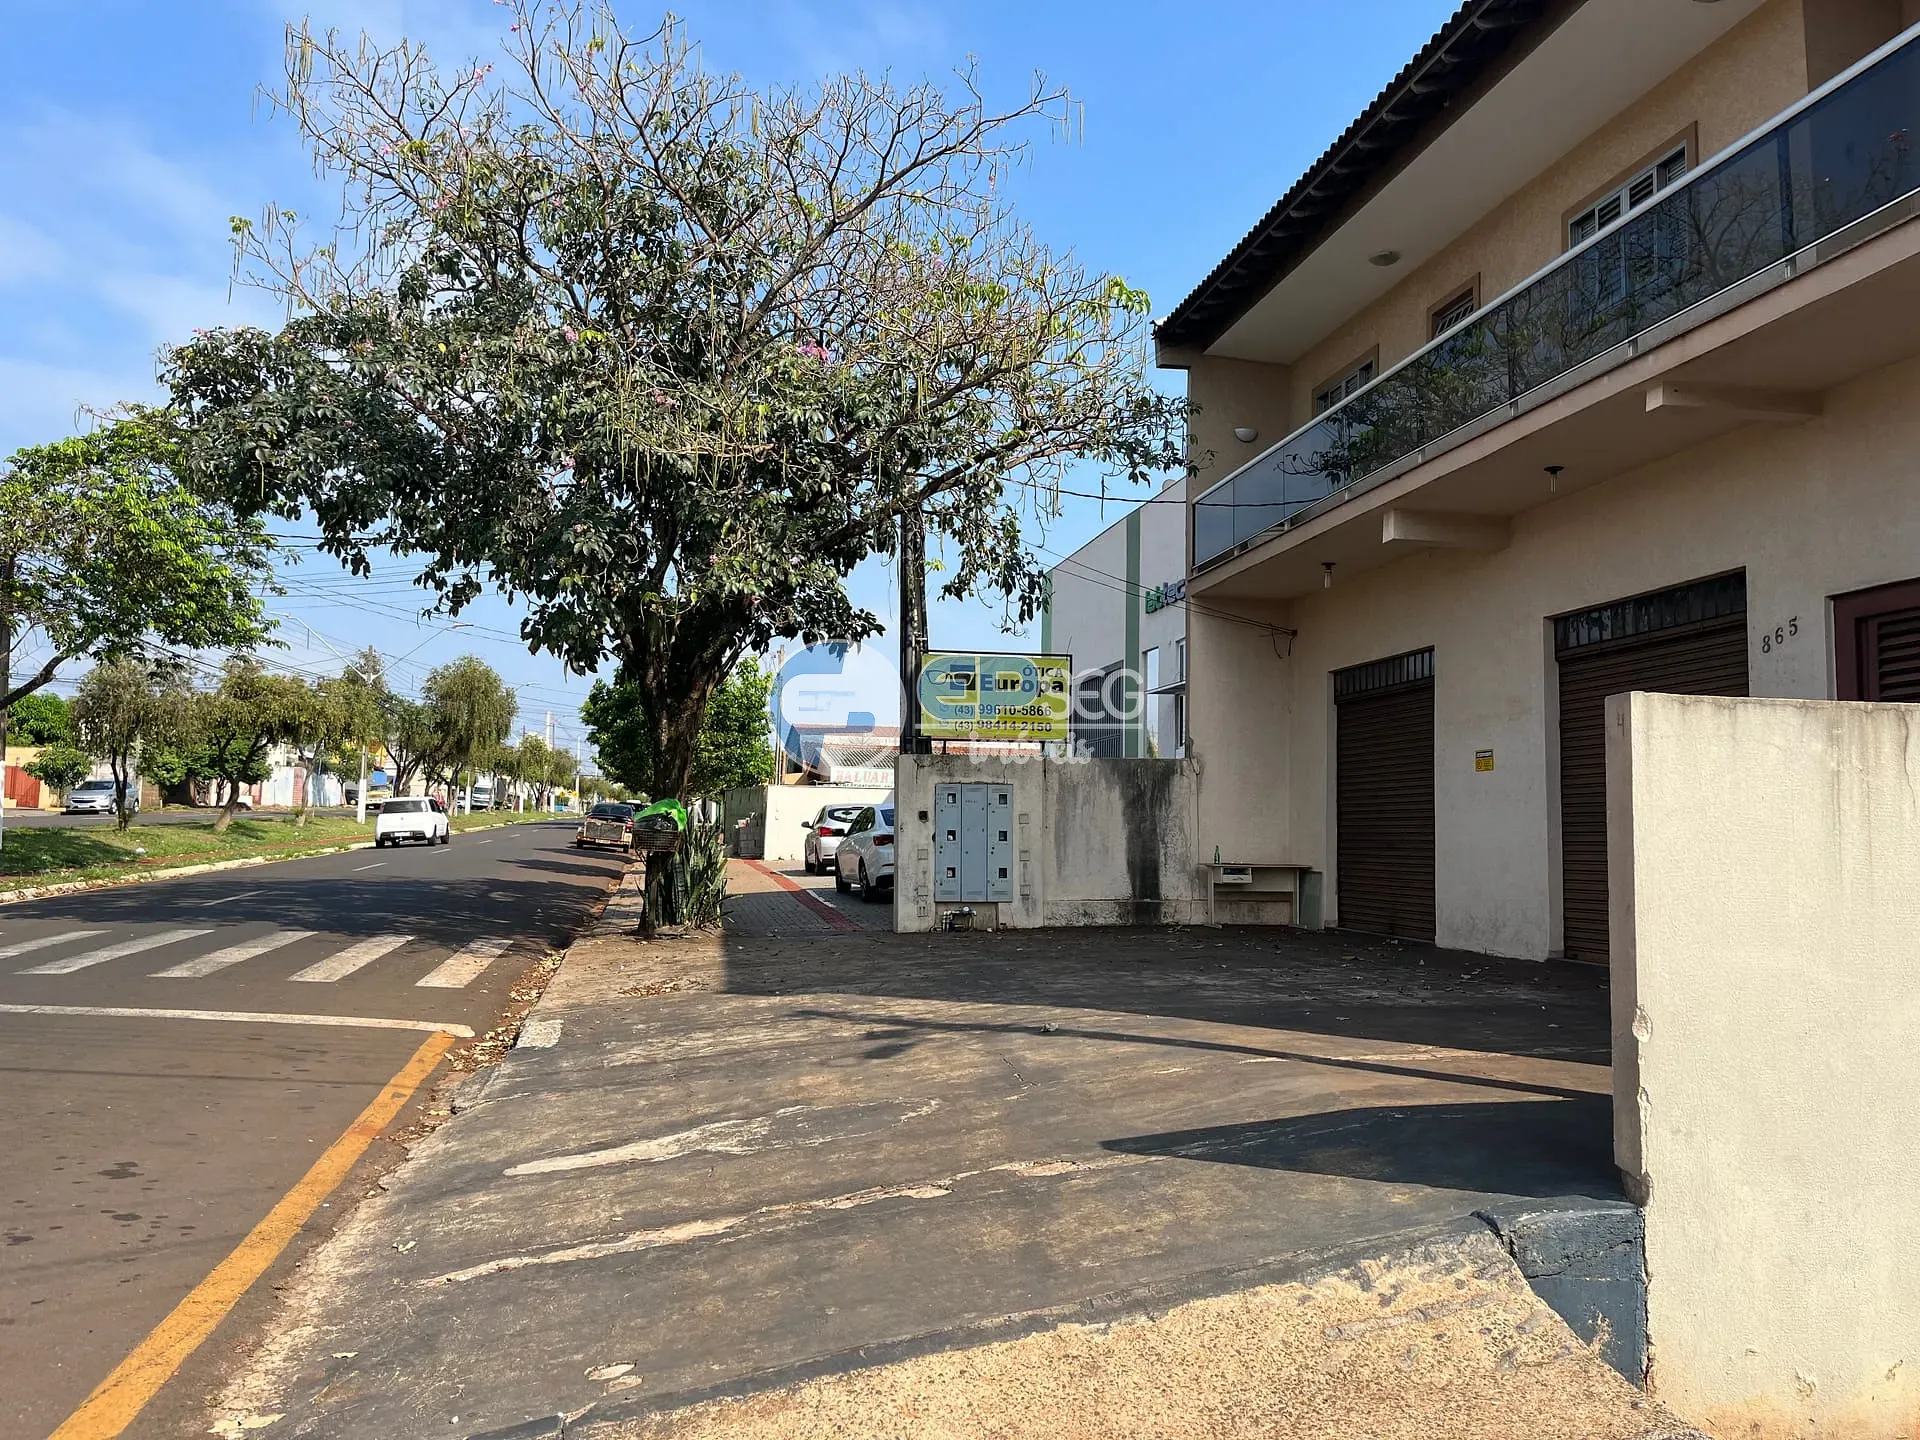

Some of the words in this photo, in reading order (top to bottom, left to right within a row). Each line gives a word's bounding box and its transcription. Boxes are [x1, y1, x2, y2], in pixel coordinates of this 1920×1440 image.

[1762, 615, 1798, 654] 865
[1022, 665, 1064, 679] ÓTICA
[979, 673, 1064, 698] Europa
[954, 704, 974, 716] (43)
[954, 720, 974, 732] (43)
[976, 719, 1053, 732] 98414-2150
